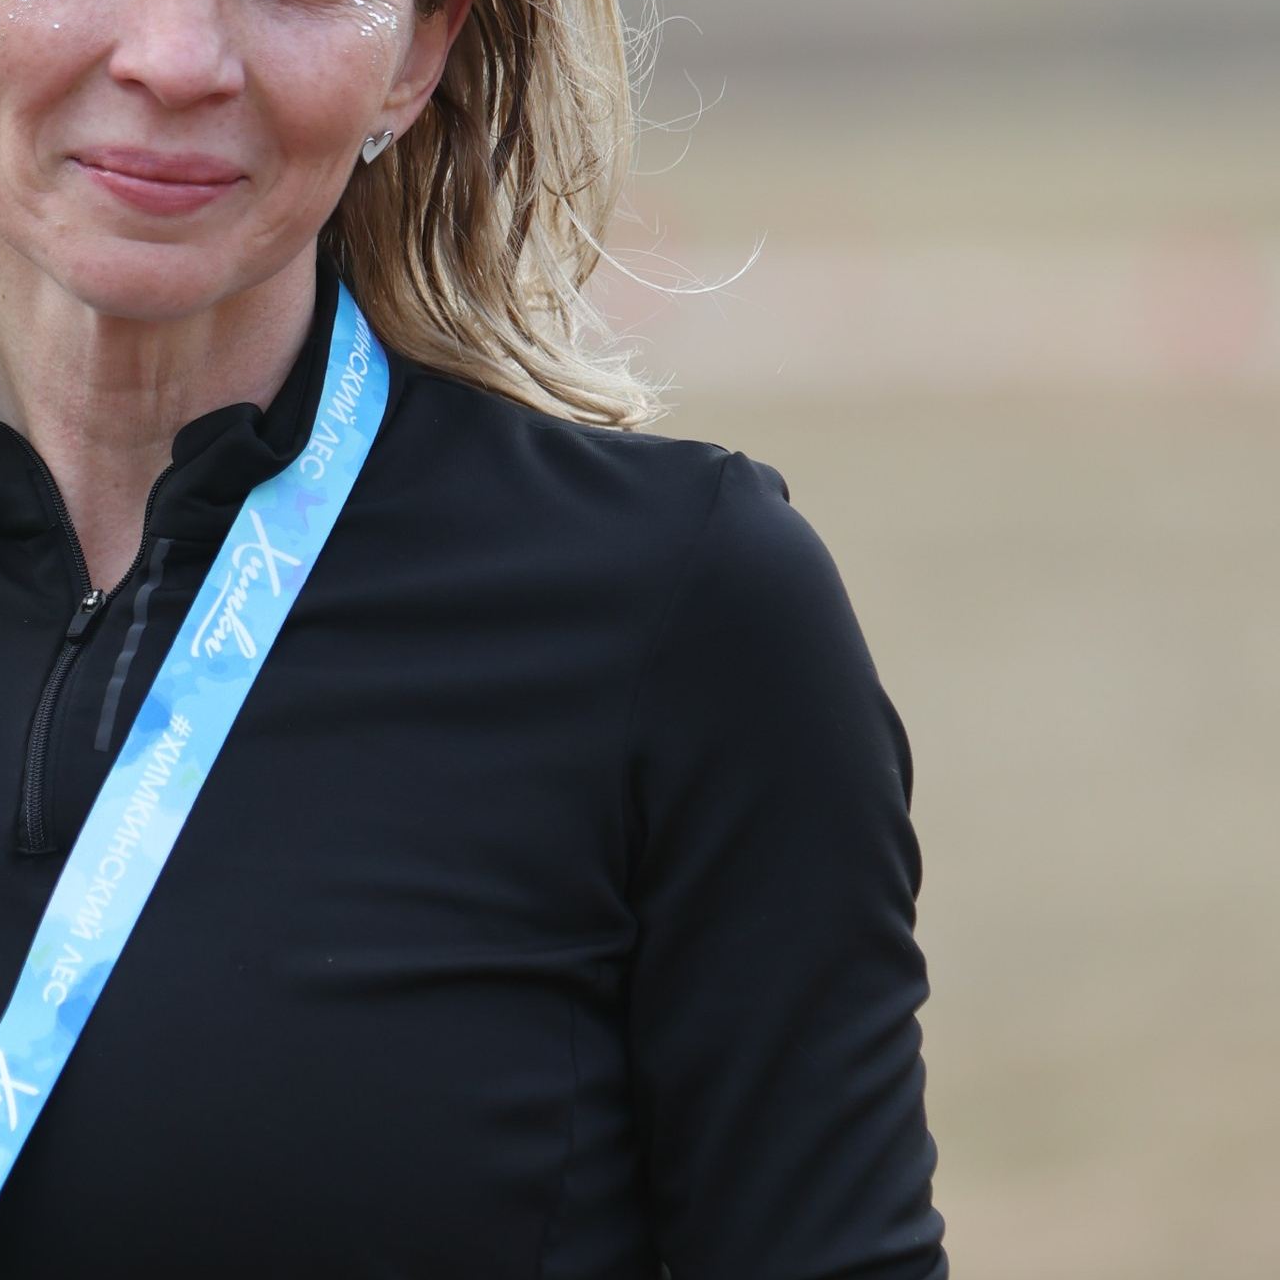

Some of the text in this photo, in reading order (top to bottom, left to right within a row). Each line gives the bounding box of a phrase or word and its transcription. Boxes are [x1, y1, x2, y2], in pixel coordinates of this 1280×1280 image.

[299, 420, 340, 480] ЛЕС
[42, 714, 193, 1008] #ХИМКИНСКИЙ ЛЕС
